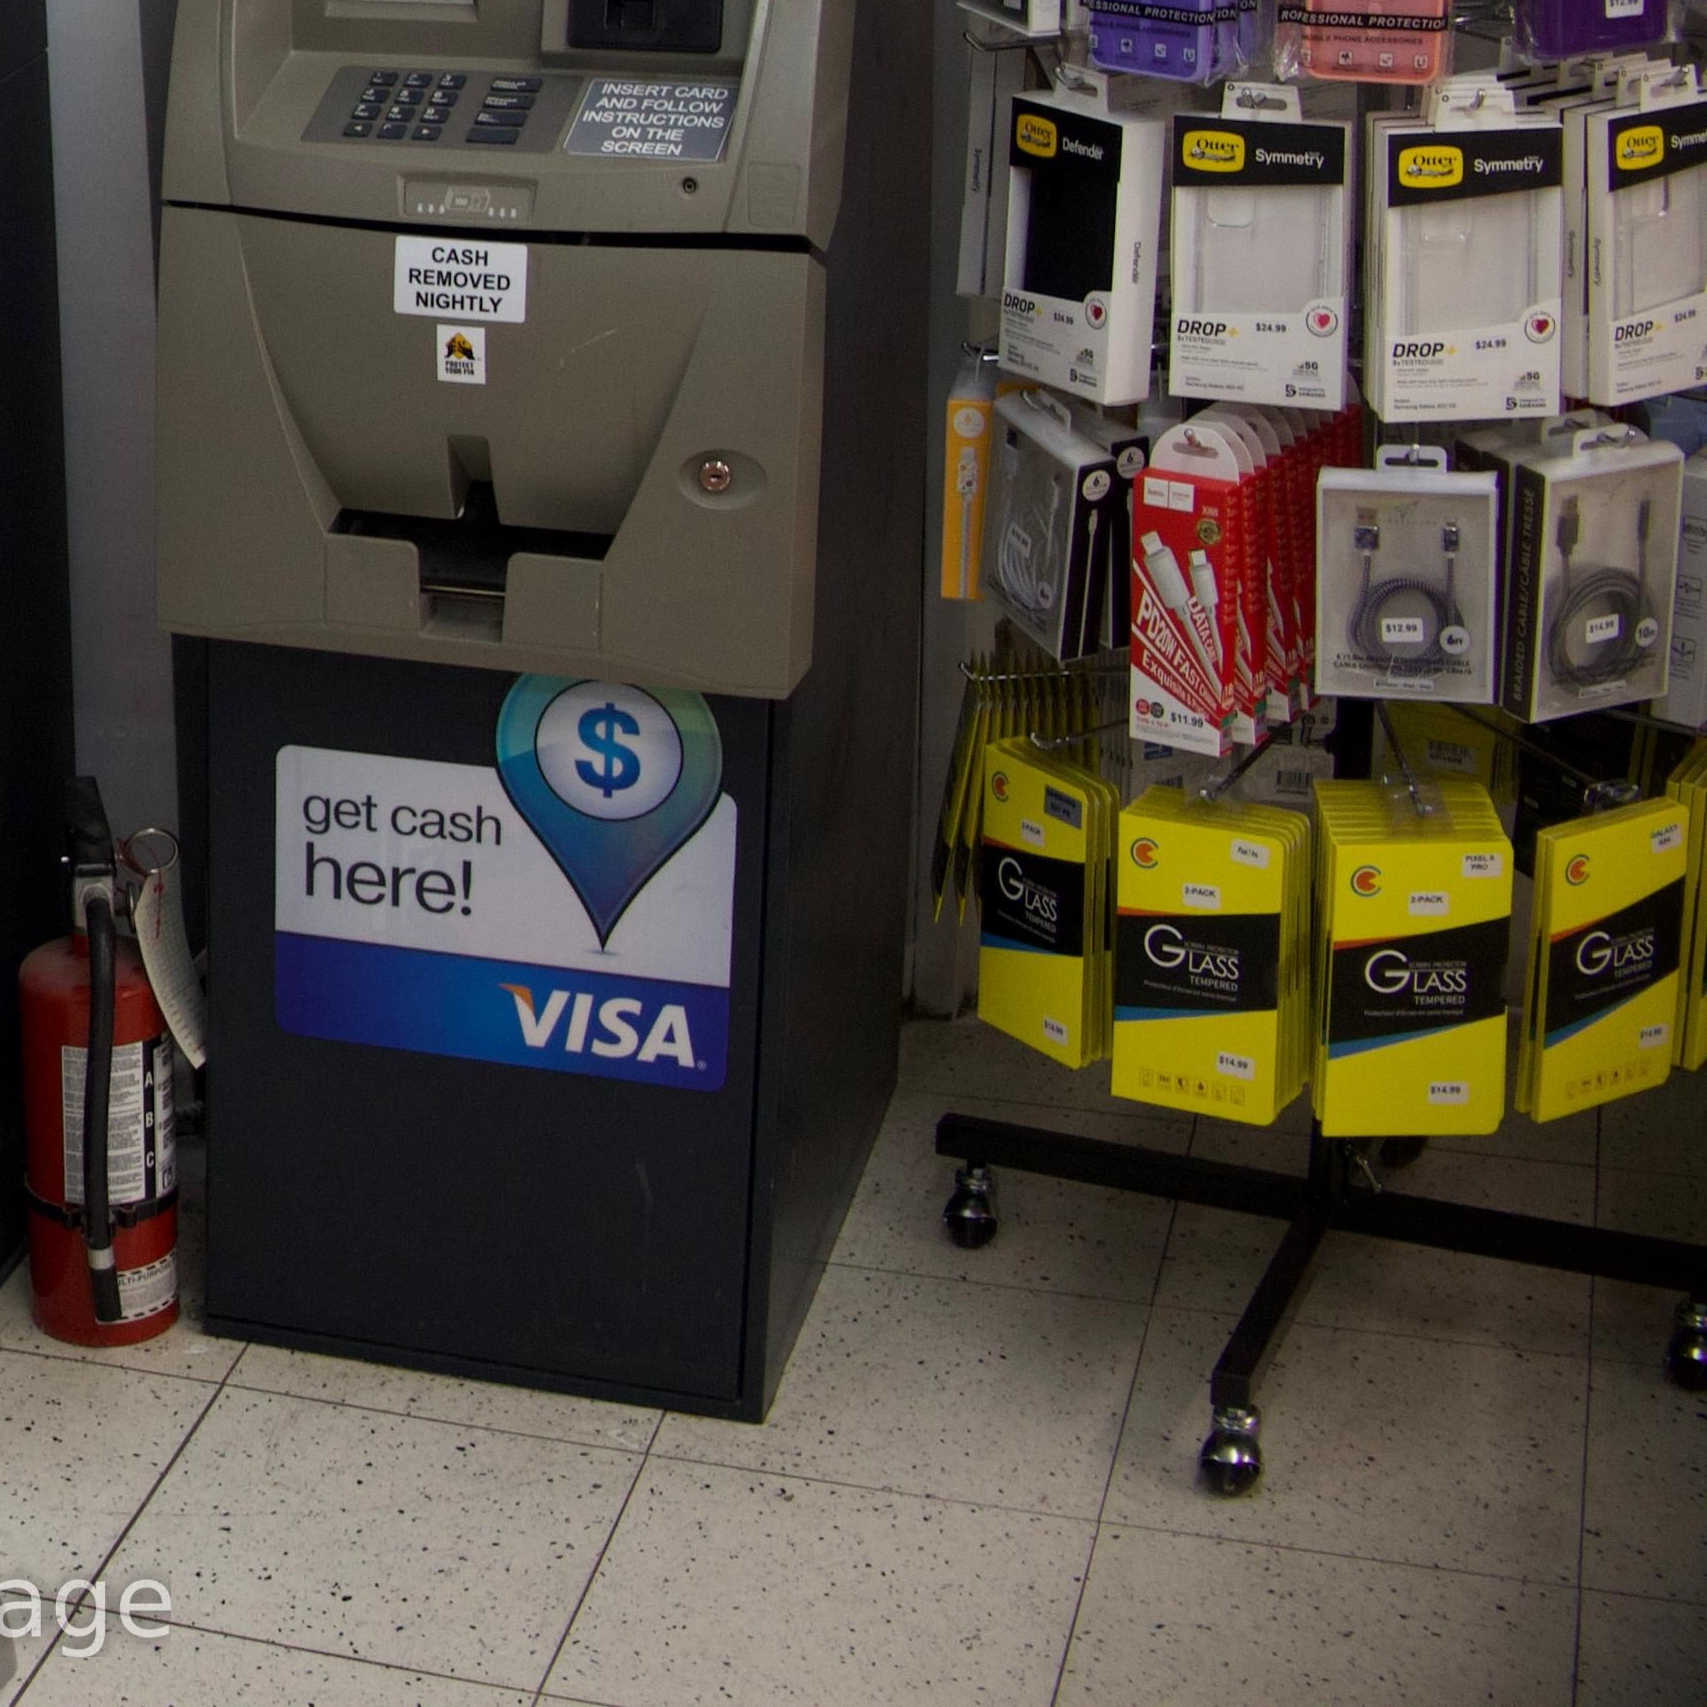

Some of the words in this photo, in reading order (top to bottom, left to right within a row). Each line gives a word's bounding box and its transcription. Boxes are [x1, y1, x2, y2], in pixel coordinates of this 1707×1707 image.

[602, 82, 669, 97] INSERT
[672, 85, 729, 100] CARD
[595, 97, 637, 110] AND
[641, 98, 724, 114] FOLLOW
[583, 110, 725, 129] INSTRUCTIONS
[612, 126, 641, 140] ON
[645, 128, 685, 142] THE
[1025, 120, 1053, 138] Otter
[600, 141, 683, 156] SCREEN
[1062, 136, 1105, 160] Defender
[1196, 138, 1240, 152] Otter
[1625, 134, 1660, 149] Otter
[1255, 148, 1325, 169] Symmetry
[1412, 154, 1457, 168] Otter
[1473, 158, 1544, 175] Symmetry
[431, 247, 489, 267] CASH
[408, 268, 512, 292] REMOVED
[415, 292, 504, 314] NIGHTLY
[1255, 322, 1287, 333] $24.99
[1475, 339, 1507, 350] $24.99
[1385, 623, 1418, 634] $12.99
[1589, 620, 1615, 634] $14.99
[1170, 711, 1204, 729] $11.99
[574, 702, 642, 800] $
[303, 794, 379, 835] get
[390, 800, 504, 848] cash
[304, 843, 475, 917] here!
[998, 857, 1058, 923] GLASS
[1025, 910, 1057, 932] TEMPERED
[1144, 924, 1239, 981] GLASS
[1575, 930, 1655, 976] GLASS
[1365, 949, 1467, 994] GLASS
[1614, 960, 1653, 979] TEMPERED
[1188, 976, 1238, 992] TEMPERED
[1413, 994, 1466, 1006] TEMPERED
[506, 985, 697, 1068] VISA
[144, 1073, 154, 1087] A
[144, 1112, 154, 1127] B
[145, 1150, 155, 1168] C
